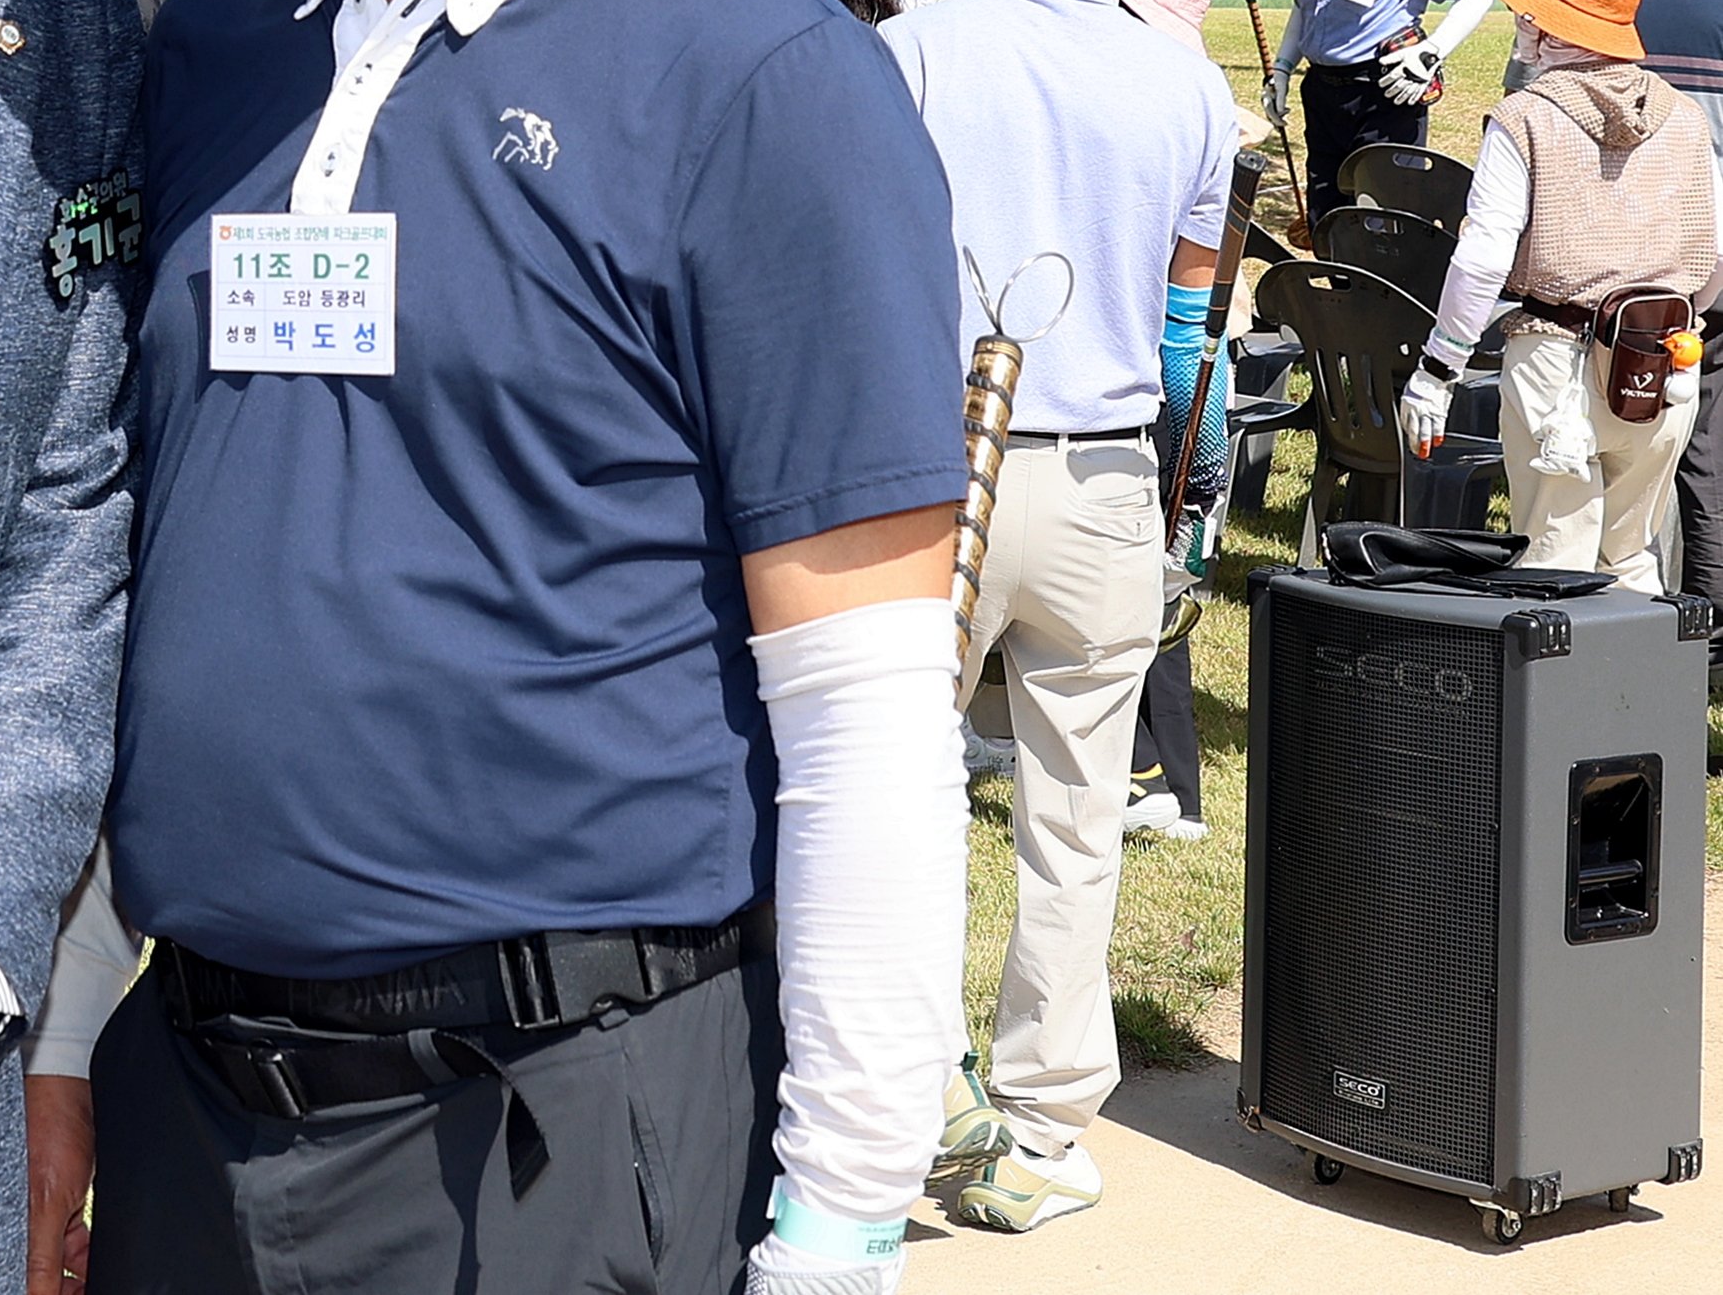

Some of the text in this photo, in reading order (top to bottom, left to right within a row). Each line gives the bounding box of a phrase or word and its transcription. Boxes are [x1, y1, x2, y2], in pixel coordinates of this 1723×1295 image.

[234, 253, 370, 279] 11조 D-2
[227, 289, 255, 306] 소속
[283, 290, 365, 308] 도암 등광리
